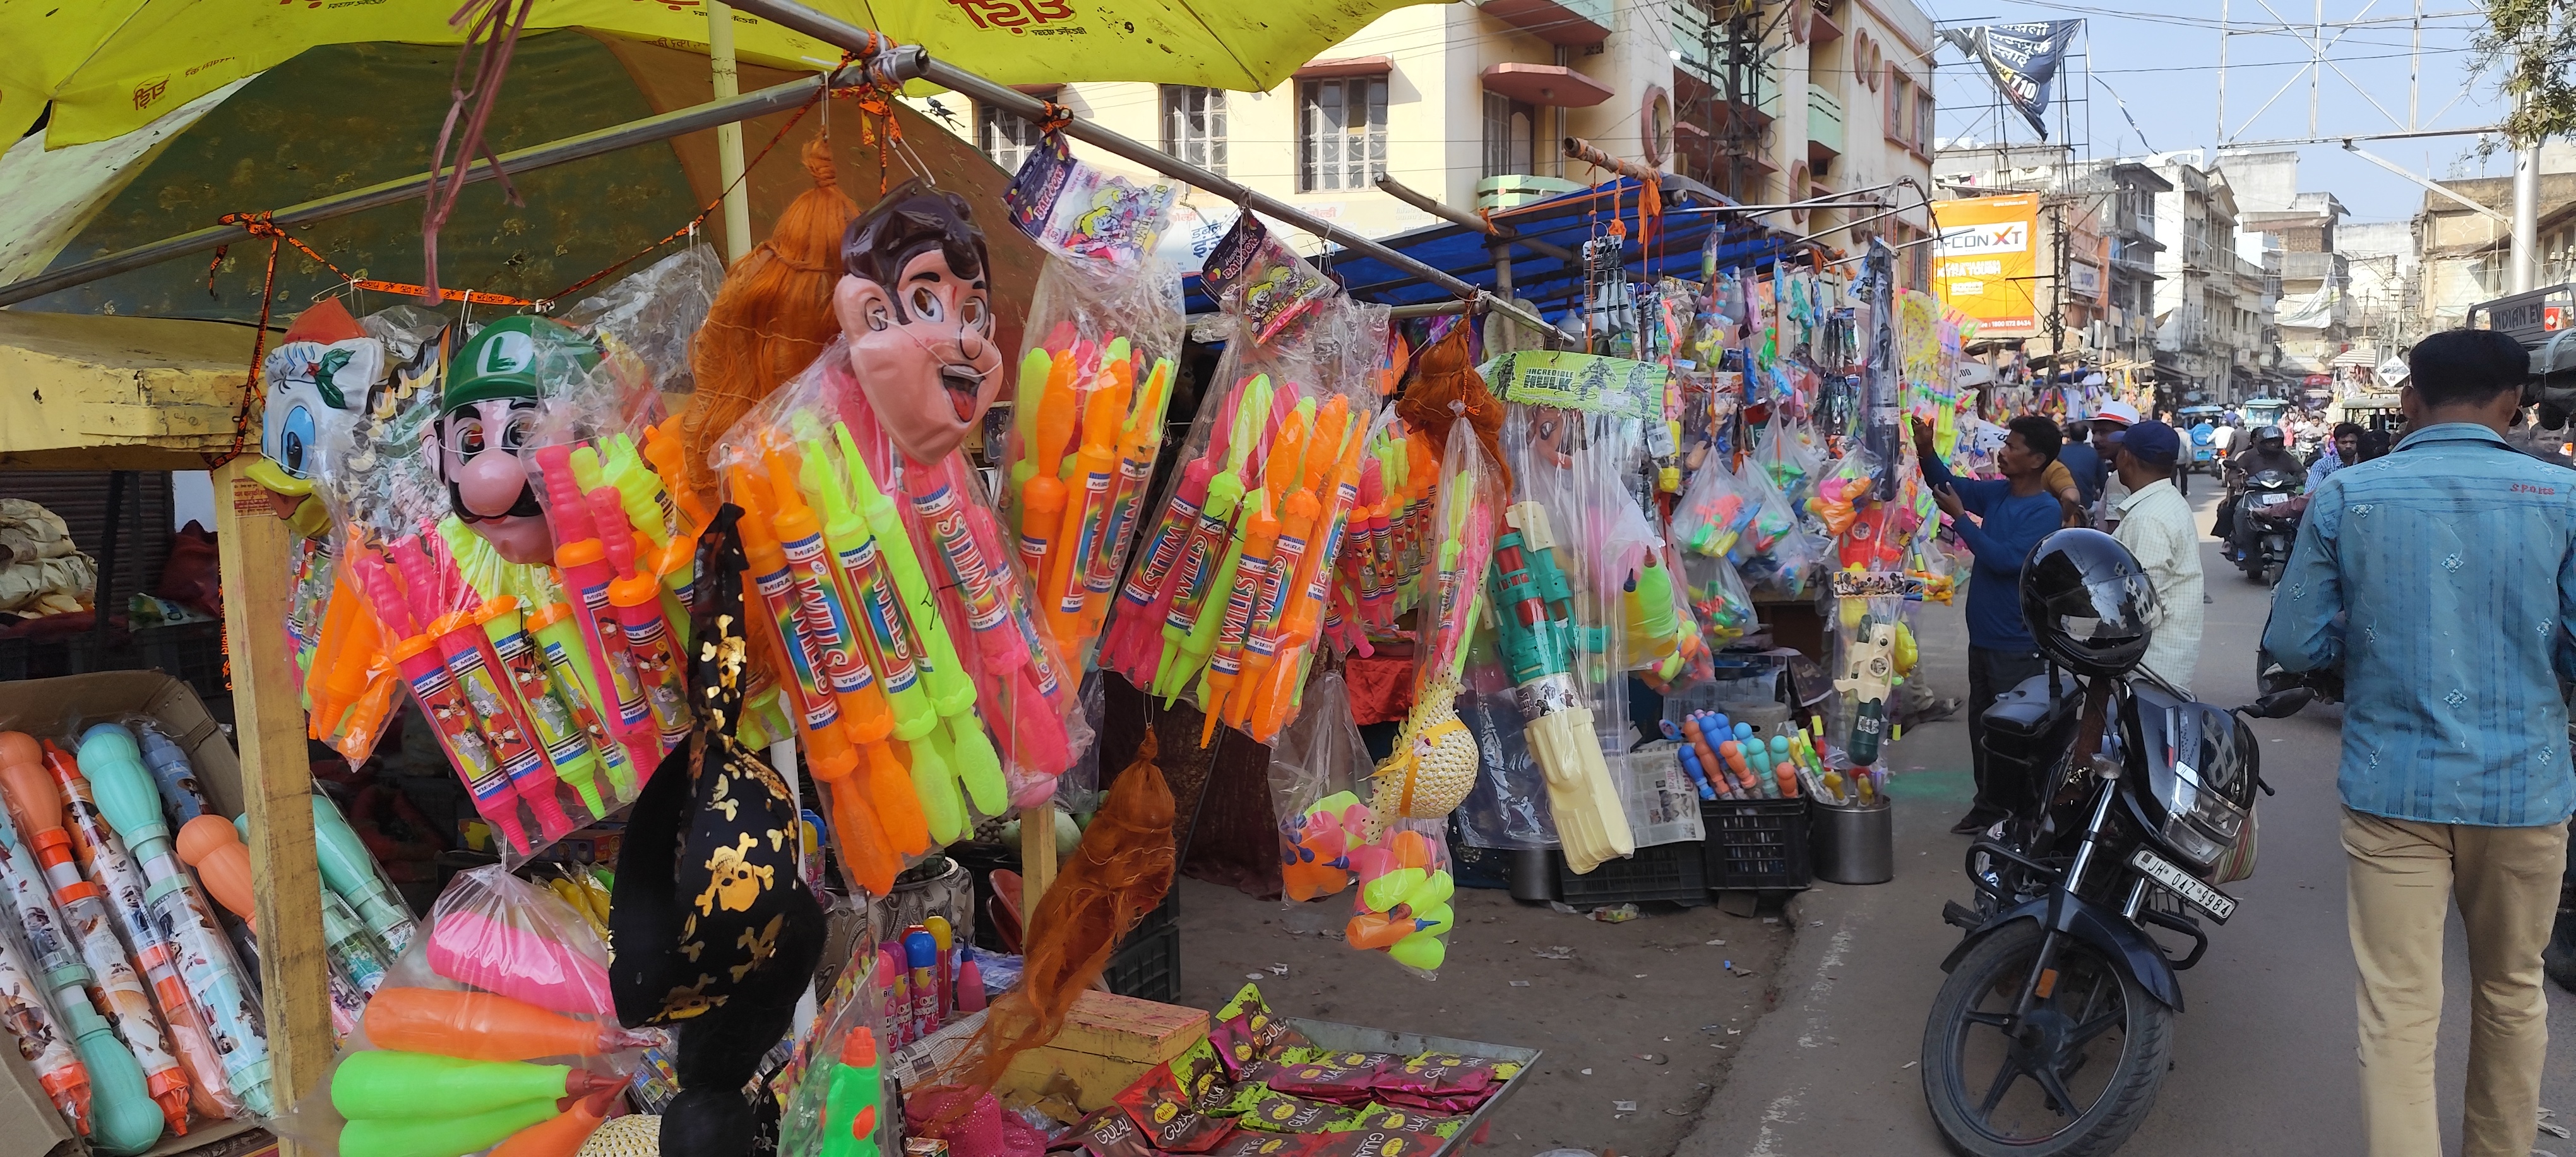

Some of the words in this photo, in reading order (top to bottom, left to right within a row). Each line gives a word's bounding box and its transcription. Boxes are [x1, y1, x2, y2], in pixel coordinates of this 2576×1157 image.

[2010, 74, 2038, 99] 710
[1034, 164, 1066, 220] BALLOONS
[487, 336, 516, 373] L
[1528, 368, 1575, 378] INCREDIBLE
[1959, 368, 1972, 378] 00
[1523, 375, 1573, 392] HULK
[1172, 500, 1188, 512] MIRA
[794, 543, 821, 557] MIRA
[936, 508, 993, 602] WILLS
[1283, 542, 1302, 552] MIRA
[847, 549, 872, 565] MIRA
[1142, 525, 1188, 587] WILLS
[1175, 534, 1208, 600] WILLS
[764, 577, 790, 592] MIRA
[1127, 585, 1144, 597] MIRA
[1253, 555, 1287, 623] WILLS
[587, 590, 606, 600] MIRA
[1219, 574, 1258, 644] WILLS
[645, 623, 662, 635] MIRA
[797, 574, 849, 668] WILLS
[499, 642, 517, 653] MIRA
[1254, 640, 1273, 649] MIRA
[460, 653, 479, 665] MIRA
[840, 669, 867, 685] MIRA
[891, 669, 914, 684] MIRA
[417, 680, 434, 691] MIRA
[624, 706, 643, 717] MIRA
[811, 705, 835, 721] MIRA
[520, 757, 538, 768] MIRA
[477, 781, 495, 793] MIRA
[2148, 860, 2166, 877] JH
[2198, 889, 2231, 916] 9984
[1202, 1085, 1225, 1108] GULA
[1157, 1105, 1176, 1121] Rakesh
[1276, 1106, 1293, 1118] Rakesh
[1287, 1106, 1320, 1127] GULAL
[1095, 1117, 1133, 1145] GULAL
[1357, 1132, 1385, 1157] GULA
[1385, 1139, 1400, 1156] Rakesh
